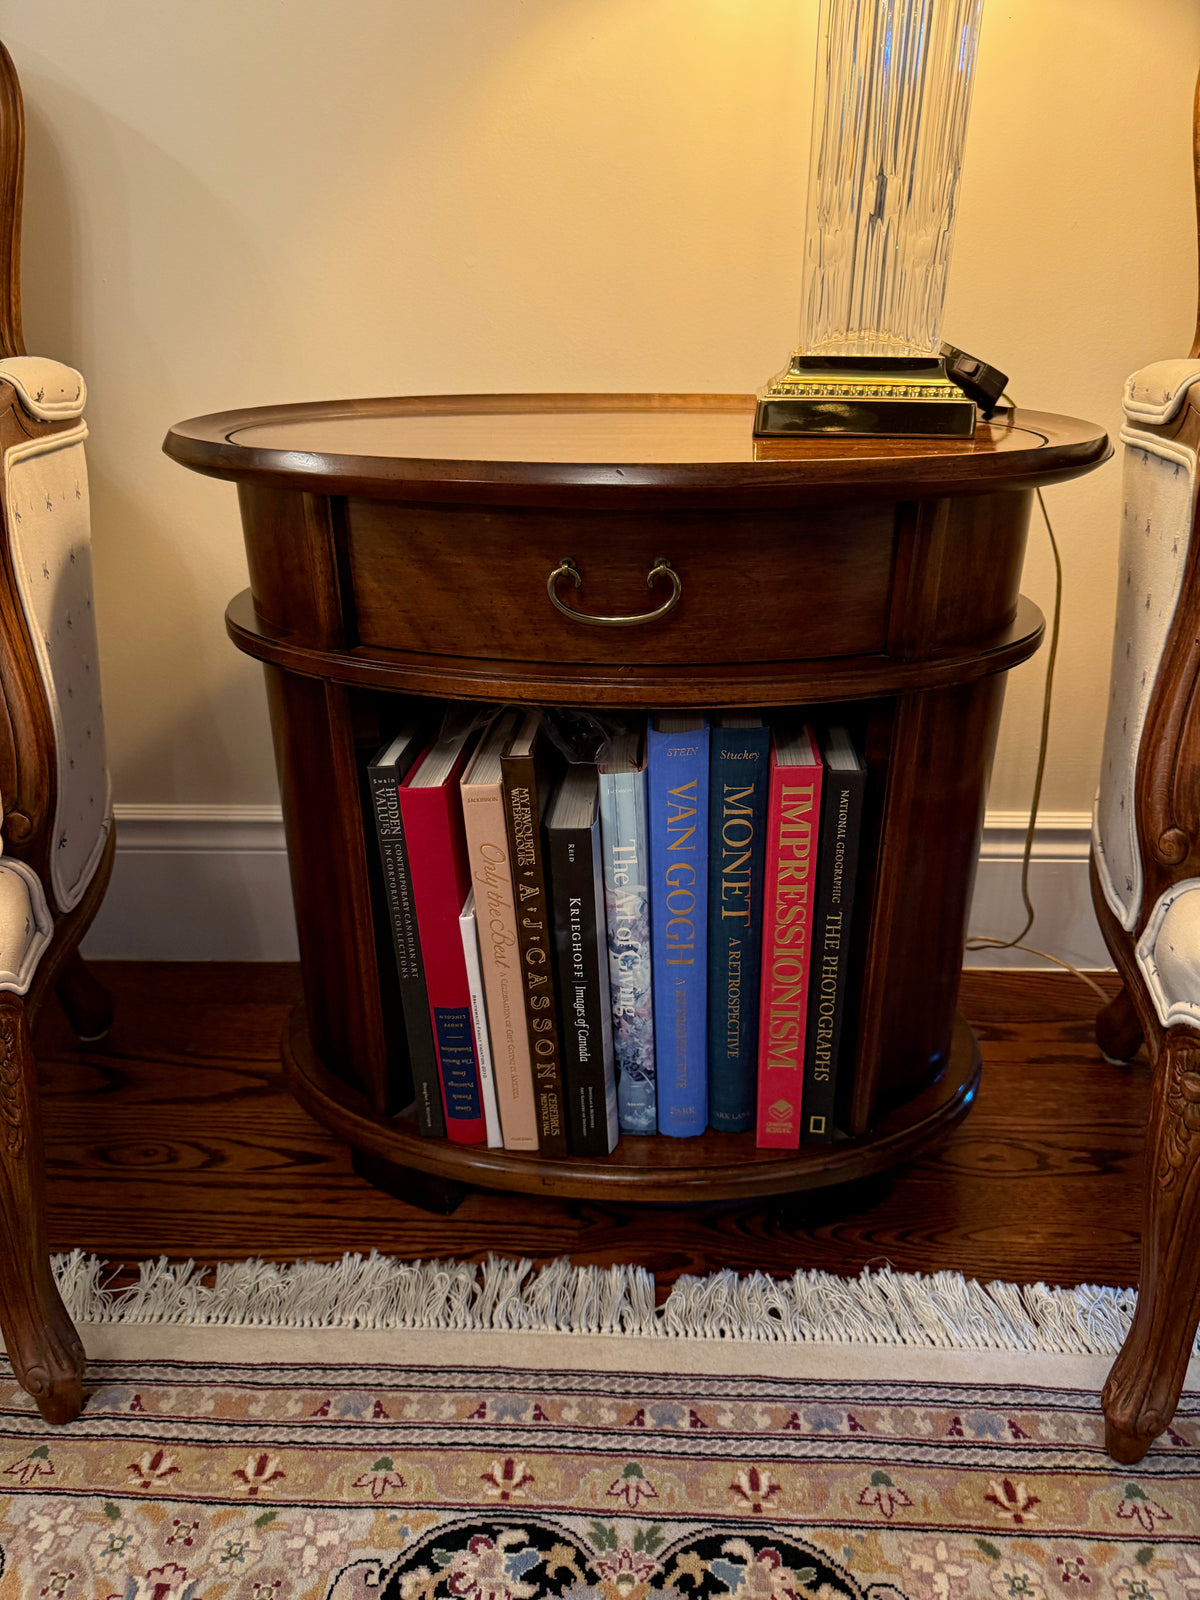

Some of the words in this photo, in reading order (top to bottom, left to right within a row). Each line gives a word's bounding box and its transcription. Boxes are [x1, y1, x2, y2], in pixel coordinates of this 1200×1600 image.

[666, 747, 699, 757] STEIN
[720, 750, 760, 762] Stuckey
[375, 788, 391, 835] VALUES
[385, 787, 402, 835] HIDDEN
[520, 787, 530, 805] MY
[666, 778, 698, 851] VAN
[837, 790, 850, 839] NATIONAL
[384, 845, 392, 855] IN
[511, 788, 526, 866] WATERCOLOURS
[521, 807, 536, 866] FAVOURITE
[395, 844, 410, 911] CONTEMPORARY
[474, 843, 509, 889] Only
[612, 839, 638, 886] The
[721, 783, 755, 927] MONET
[831, 841, 845, 903] GEOGRAPHIC
[386, 858, 400, 910] CORPORATE
[487, 891, 512, 917] the
[519, 883, 540, 902] A
[614, 888, 638, 923] Art
[404, 913, 417, 959] CANADIAN
[522, 917, 543, 930] J
[569, 898, 584, 978] KRIEGHOFF
[616, 927, 641, 949] of
[665, 863, 697, 966] GOGH
[768, 783, 814, 1071] IMPRESSIONISM
[823, 911, 843, 950] THE
[394, 914, 409, 978] COLLECTIONS
[490, 919, 516, 968] Best
[729, 937, 742, 947] A
[410, 962, 419, 978] ART
[614, 949, 641, 1017] Giving
[675, 977, 686, 986] A
[526, 947, 557, 1079] CASSON
[573, 986, 587, 1017] Images
[574, 1018, 589, 1031] of
[727, 951, 741, 1059] RETROSPECTIVE
[814, 955, 840, 1081] PHOTOGRAPHS
[577, 1029, 592, 1063] Canada
[675, 990, 687, 1089] RETROSPECTIVE
